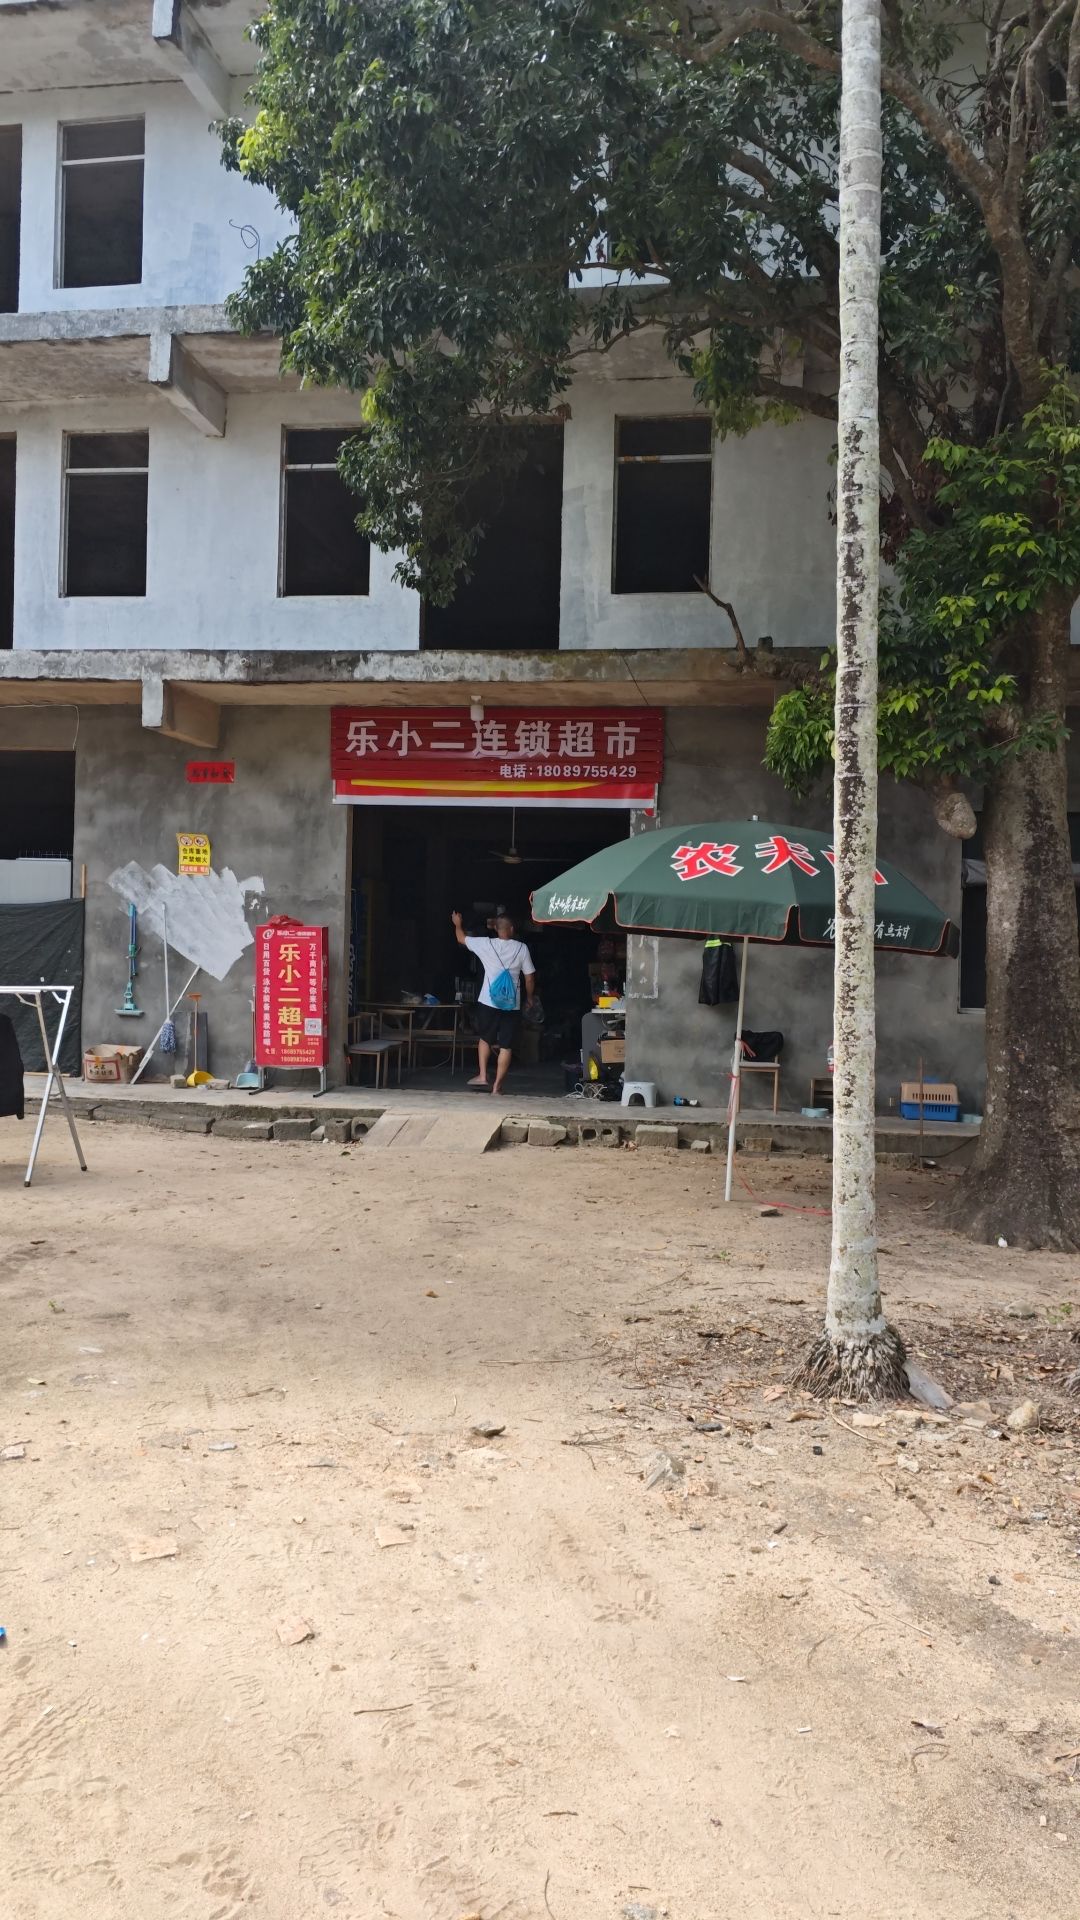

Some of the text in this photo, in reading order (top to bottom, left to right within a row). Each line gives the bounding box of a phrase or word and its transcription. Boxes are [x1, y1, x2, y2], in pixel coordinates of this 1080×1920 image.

[345, 719, 641, 759] 乐小二连锁超市
[182, 847, 208, 856] 仓库重地
[182, 855, 208, 864] 严禁烟火
[309, 943, 317, 977] 万千商品
[278, 943, 302, 1047] 乐小二超市
